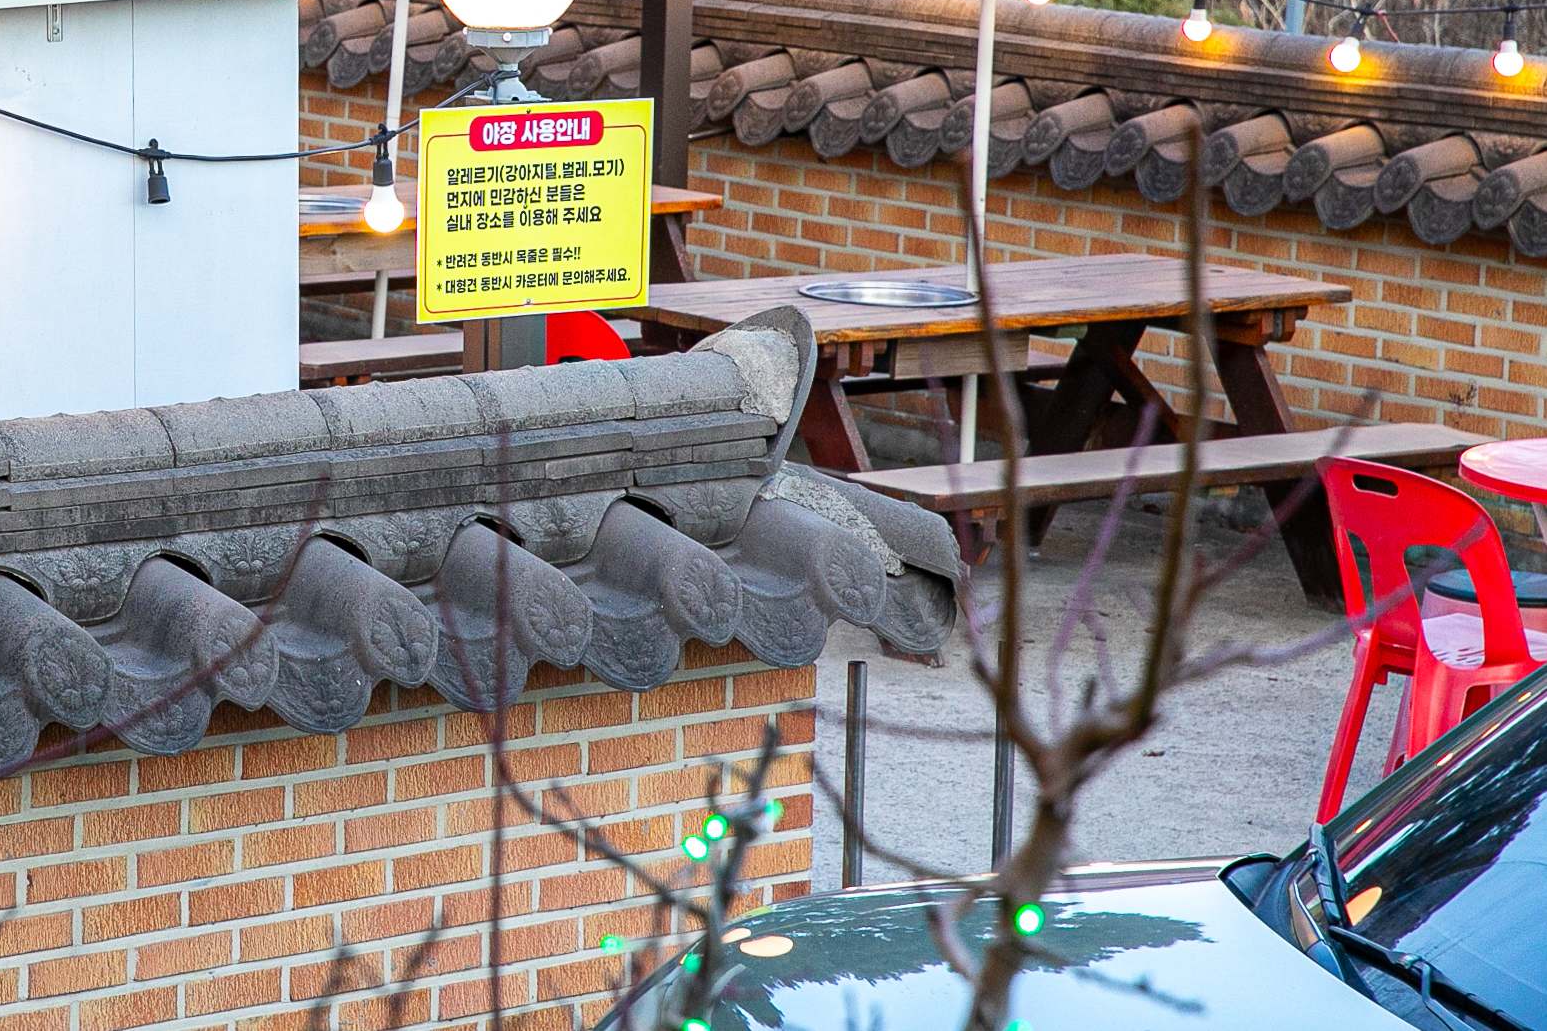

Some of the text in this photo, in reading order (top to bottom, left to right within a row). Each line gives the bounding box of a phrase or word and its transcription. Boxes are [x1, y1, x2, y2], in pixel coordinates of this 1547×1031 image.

[482, 117, 591, 145] 야장 사용안내
[447, 158, 625, 186] 알레르기(강아지털.벌레.모기)
[447, 183, 585, 209] 먼지에 민감하신 분들은
[446, 205, 602, 232] 실내 장소를 이용해 주세요
[445, 246, 581, 269] 반려견 동반시 목줄은 필수!!
[445, 268, 631, 294] 대형견 동반시 카운터에 문의해주세요.
